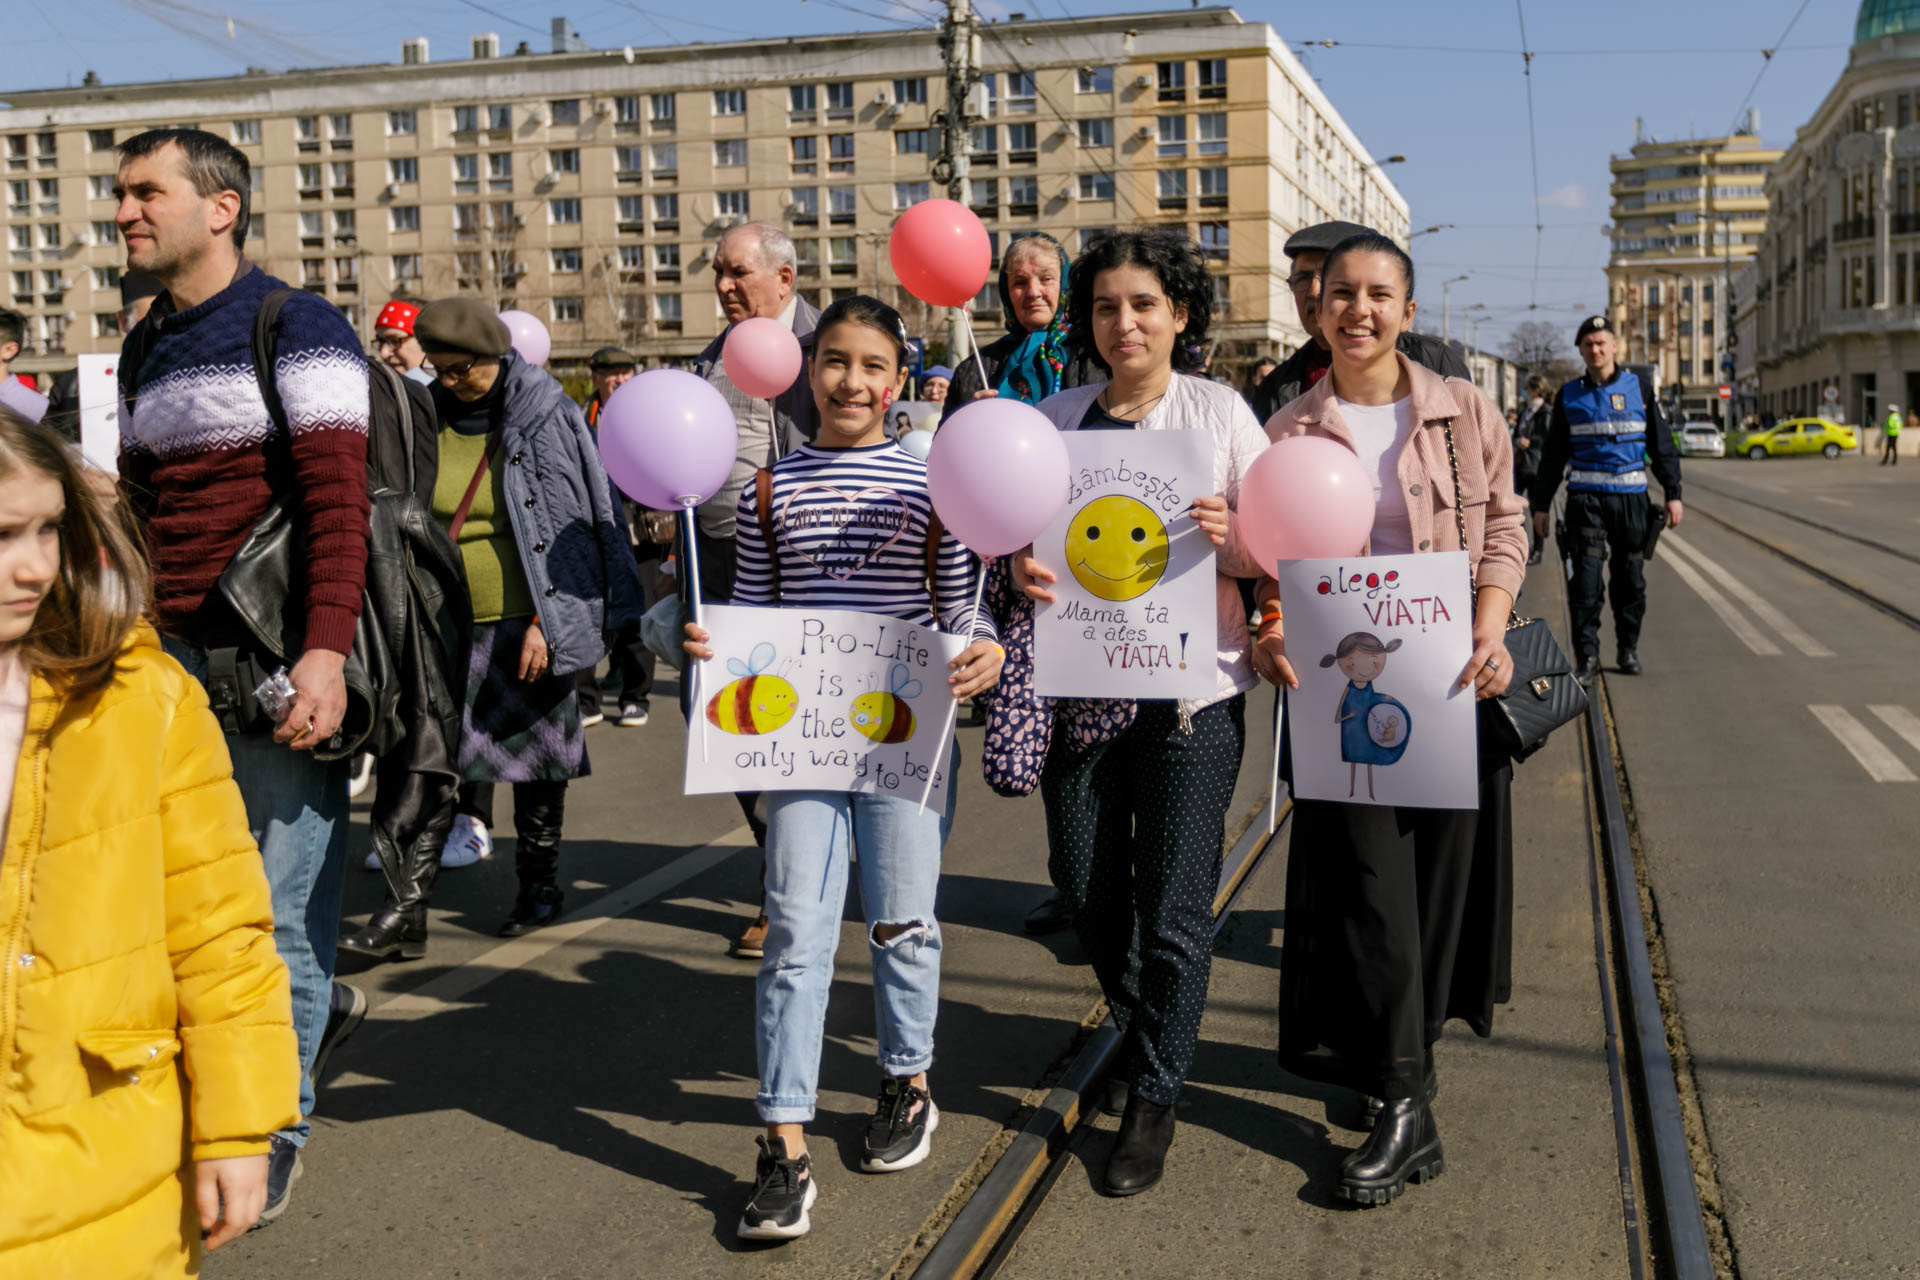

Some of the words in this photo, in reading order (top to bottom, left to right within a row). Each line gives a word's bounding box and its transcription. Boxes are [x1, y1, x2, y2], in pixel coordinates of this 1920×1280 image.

[1316, 566, 1400, 600] alege
[1057, 600, 1129, 624] Mama
[1144, 601, 1170, 624] ta
[800, 618, 930, 668] Pro-Life
[1082, 625, 1097, 641] a
[1104, 625, 1149, 643] ales
[816, 669, 844, 698] is
[800, 708, 846, 739] the
[735, 741, 795, 777] only
[808, 749, 869, 778] way
[875, 763, 900, 790] to
